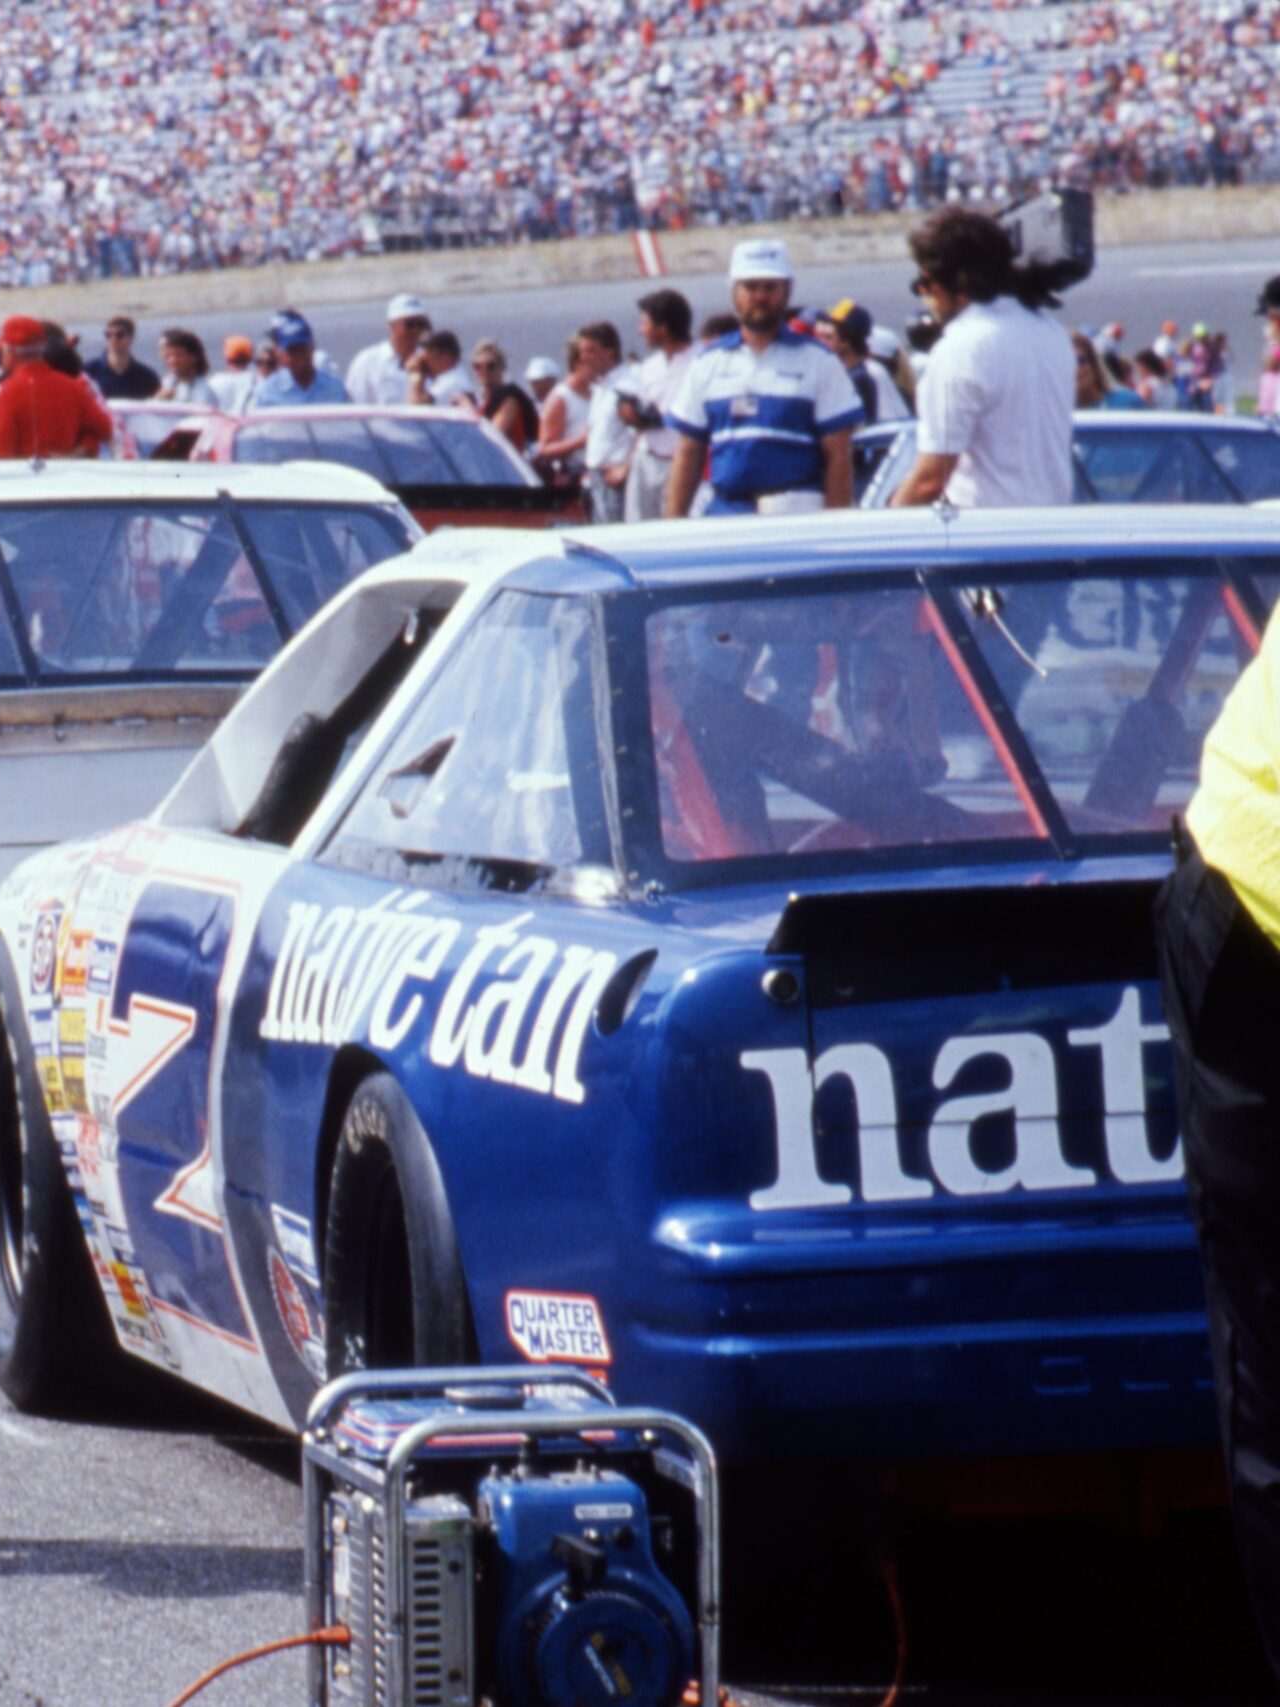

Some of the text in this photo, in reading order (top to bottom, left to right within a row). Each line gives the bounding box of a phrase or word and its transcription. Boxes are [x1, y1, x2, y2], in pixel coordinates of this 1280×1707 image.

[259, 887, 617, 1104] native tan
[739, 985, 1186, 1211] nat
[510, 1298, 595, 1334] QUARTER
[529, 1326, 603, 1356] MASTER
